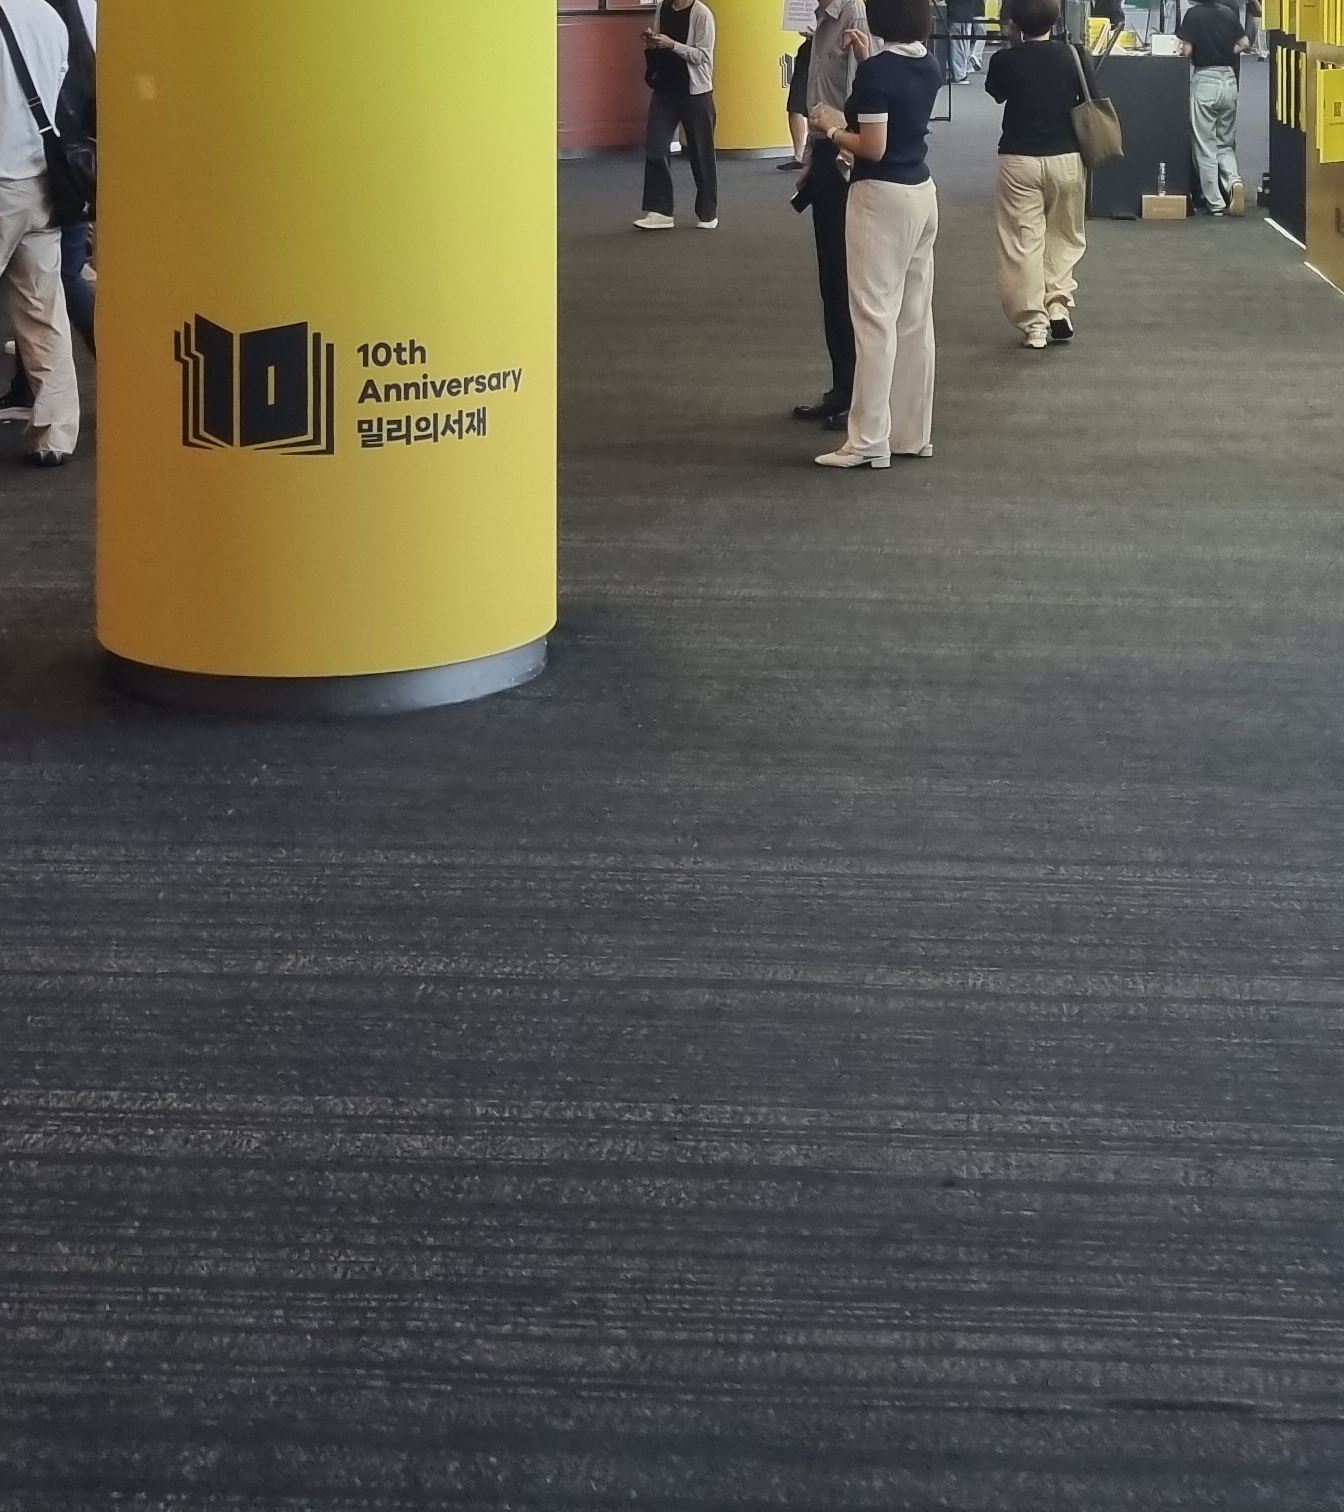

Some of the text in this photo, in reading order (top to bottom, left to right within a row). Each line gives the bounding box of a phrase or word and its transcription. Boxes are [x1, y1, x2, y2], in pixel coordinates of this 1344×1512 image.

[357, 339, 427, 368] 10th
[357, 367, 523, 405] Anniversary
[357, 407, 488, 449] 밀리의서재
